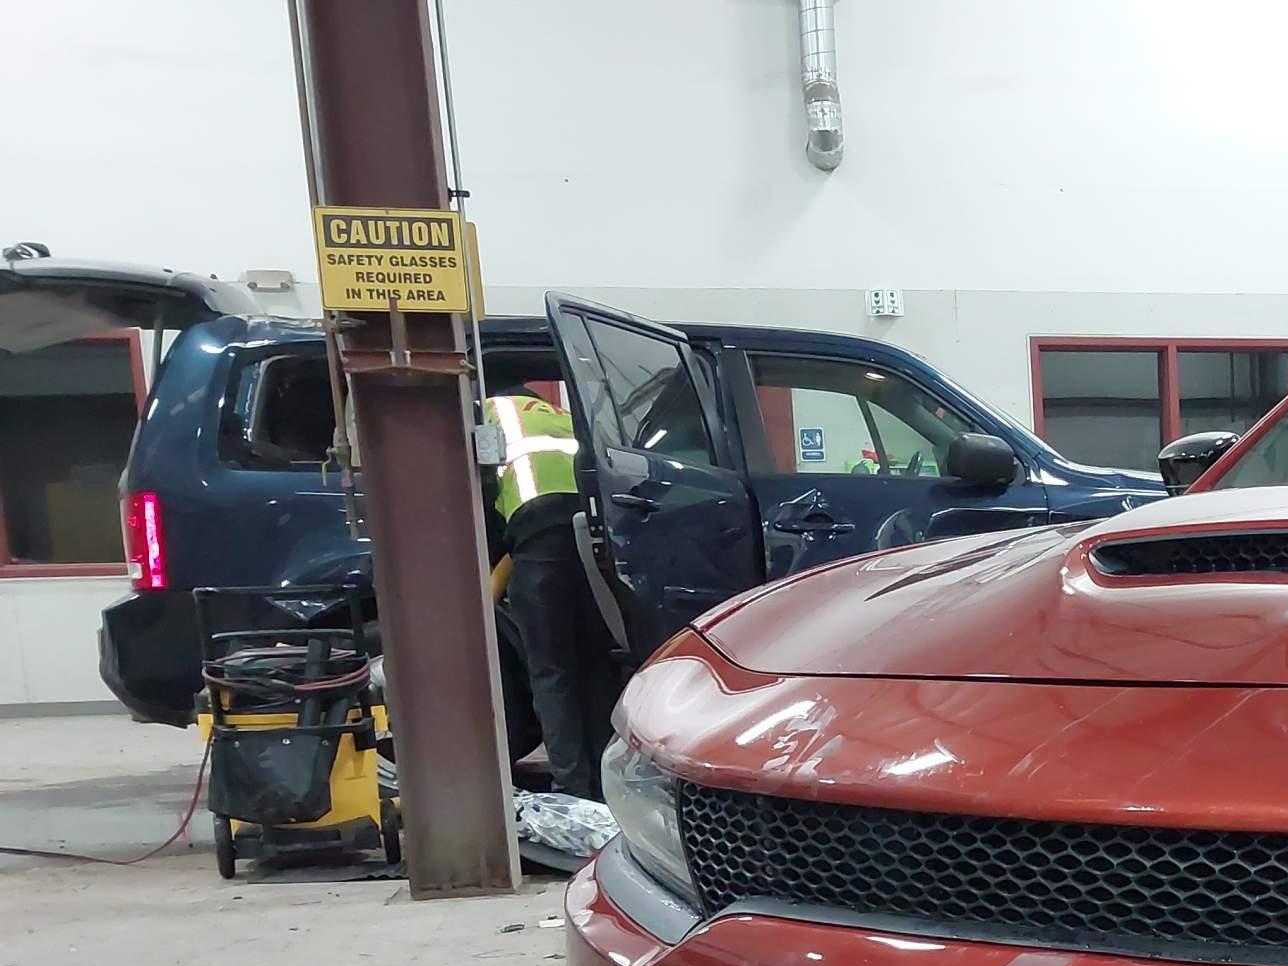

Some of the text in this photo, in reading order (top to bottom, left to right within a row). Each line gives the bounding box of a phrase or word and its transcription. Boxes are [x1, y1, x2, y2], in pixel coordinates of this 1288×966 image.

[330, 219, 450, 247] CAUTION
[327, 254, 457, 268] SAFETY GLASSES
[355, 271, 433, 284] REQUIRED
[345, 288, 446, 301] IN THIS AREA
